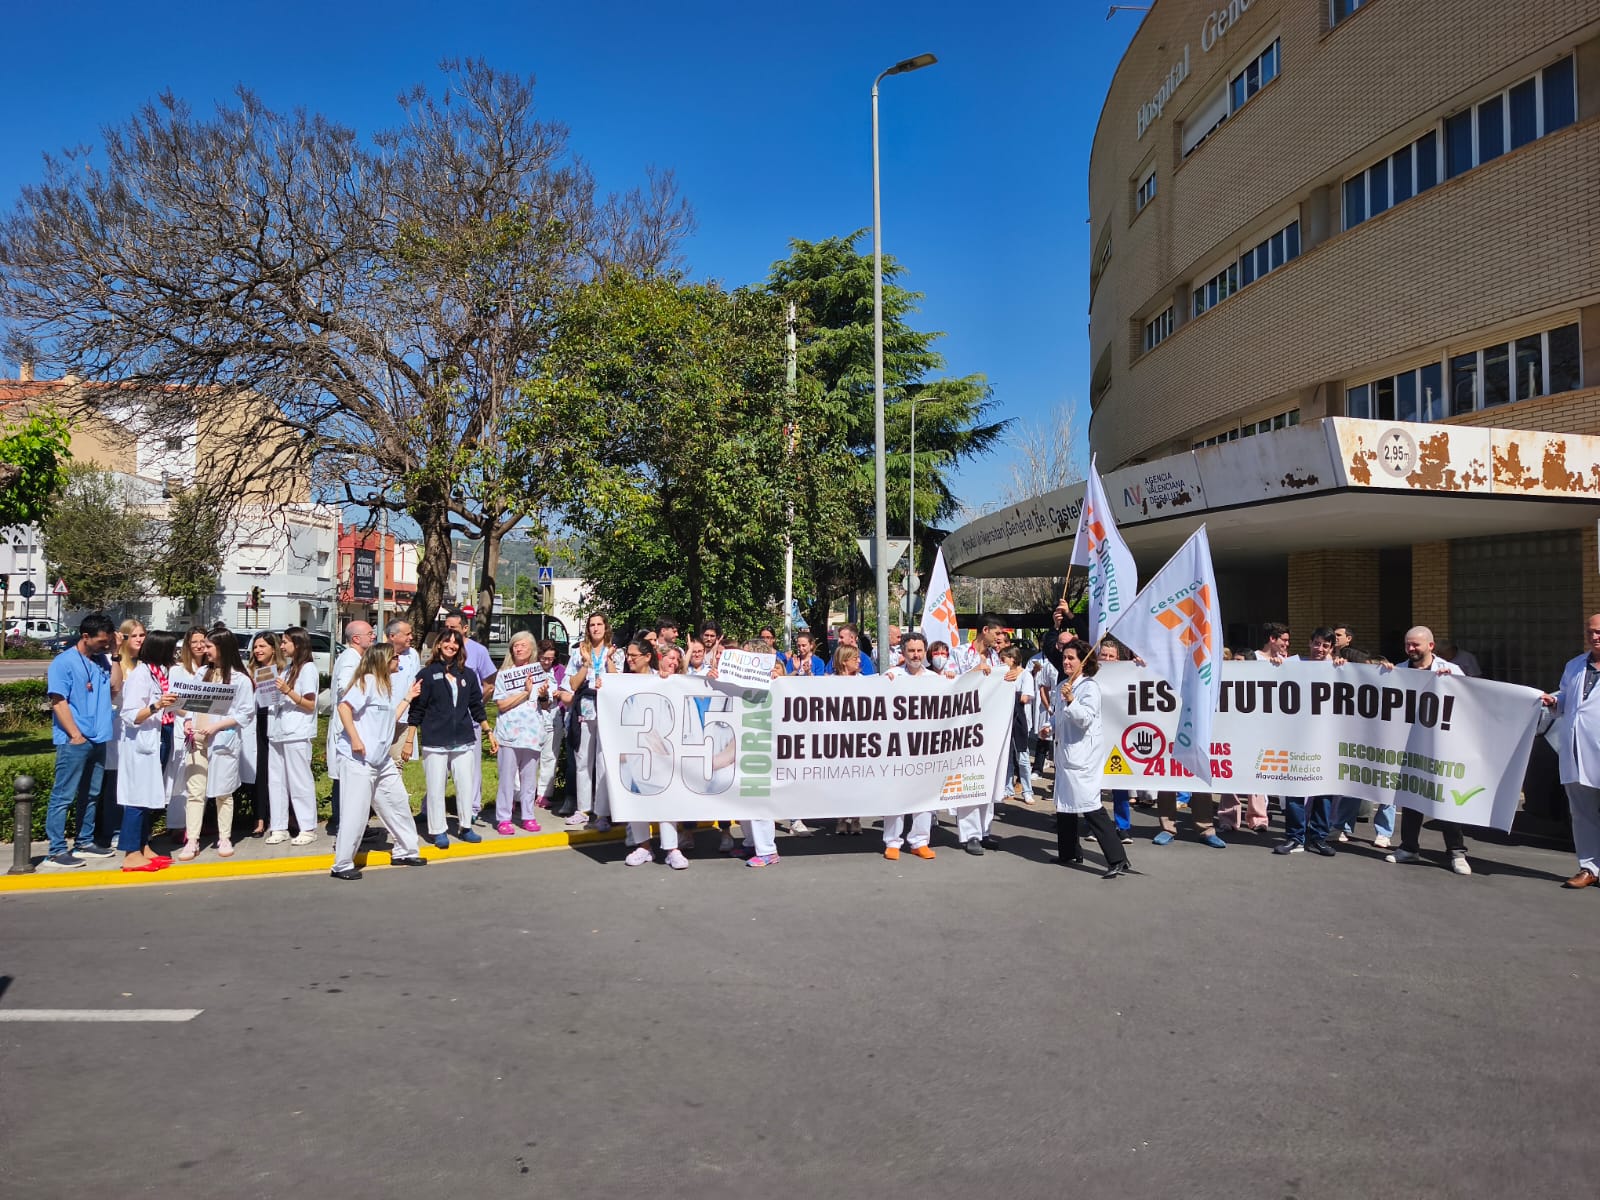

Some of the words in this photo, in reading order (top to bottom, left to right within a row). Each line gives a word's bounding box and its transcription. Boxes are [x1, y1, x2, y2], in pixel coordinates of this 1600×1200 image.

[1137, 43, 1190, 141] Hospital
[1144, 472, 1173, 485] AGENCIA
[1147, 480, 1186, 494] VALENCIANA
[1005, 517, 1035, 537] General
[1150, 576, 1204, 615] cesmcv
[202, 684, 235, 694] AGOTADOS
[782, 696, 888, 722] JORNADA
[893, 689, 981, 720] SEMANAL
[1311, 681, 1455, 731] PROPIO!
[619, 692, 736, 796] 35
[739, 689, 774, 797] HORAS
[776, 734, 805, 760] DE
[811, 732, 882, 759] LUNES
[887, 732, 902, 757] A
[907, 723, 984, 756] VIERNES
[1289, 751, 1322, 761] Sindicato
[776, 767, 797, 780] EN
[803, 765, 875, 780] PRIMARIA
[879, 764, 889, 777] Y
[893, 754, 985, 777] HOSPITALARIA
[1143, 758, 1165, 776] 24
[1338, 742, 1466, 780] RECONOCIMIENTO
[1338, 763, 1446, 803] PROFESIONAL
